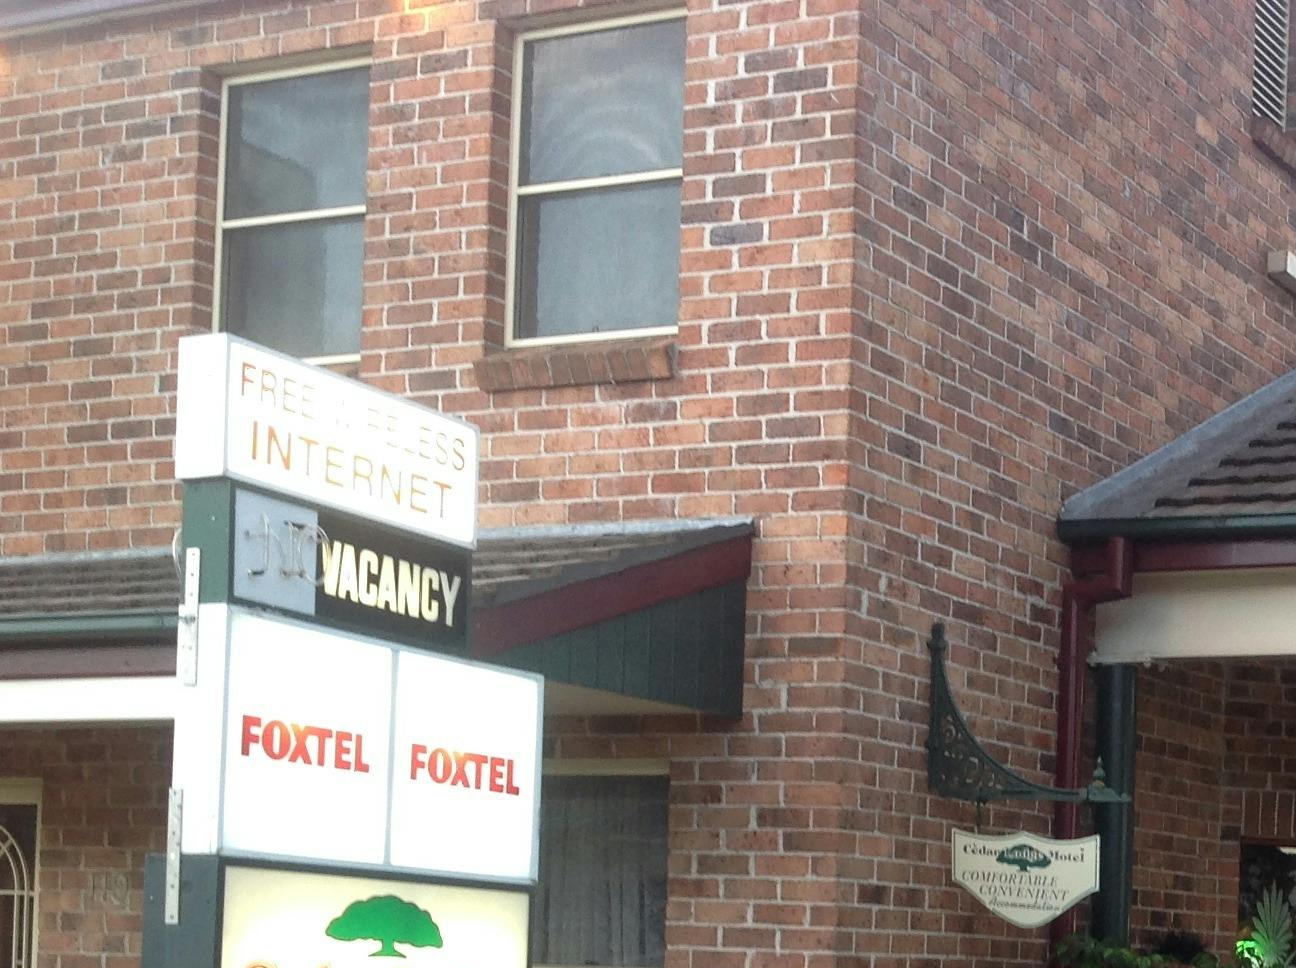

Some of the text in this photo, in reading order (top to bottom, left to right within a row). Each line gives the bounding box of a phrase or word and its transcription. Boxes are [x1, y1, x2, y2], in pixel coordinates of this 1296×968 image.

[240, 360, 317, 422] FREE
[251, 420, 453, 519] INTERNET
[322, 541, 461, 628] VACANCY
[240, 715, 370, 774] FOXTEL
[410, 743, 520, 797] FOXTEL
